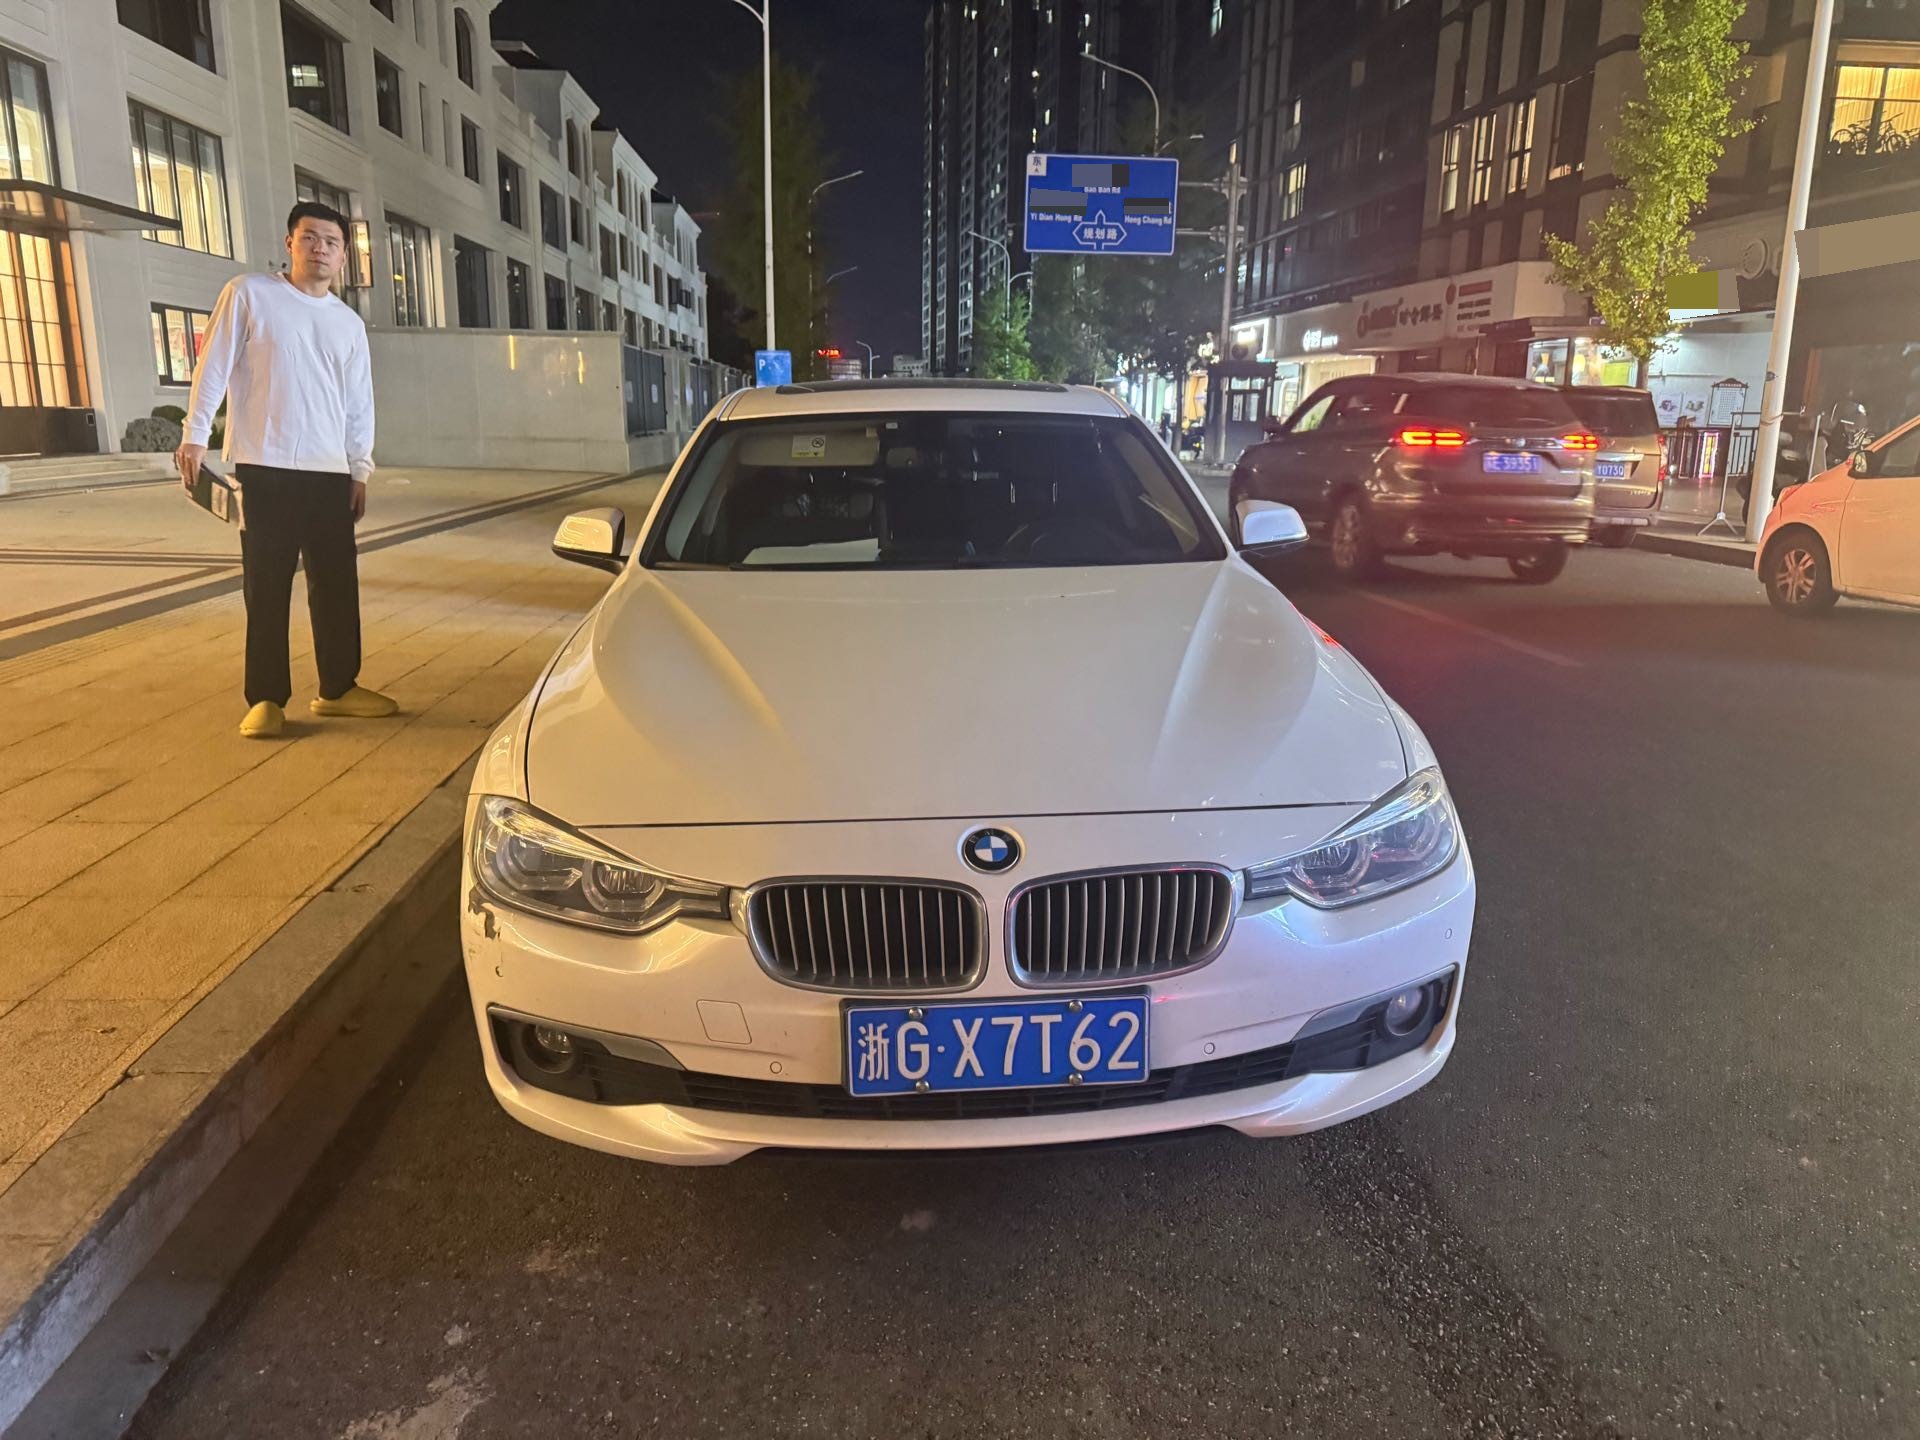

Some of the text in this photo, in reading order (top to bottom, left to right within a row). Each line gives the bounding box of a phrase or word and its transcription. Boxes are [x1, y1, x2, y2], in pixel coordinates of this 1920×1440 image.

[1163, 216, 1172, 225] Rd
[1083, 227, 1117, 240] 规划路
[758, 359, 766, 371] P
